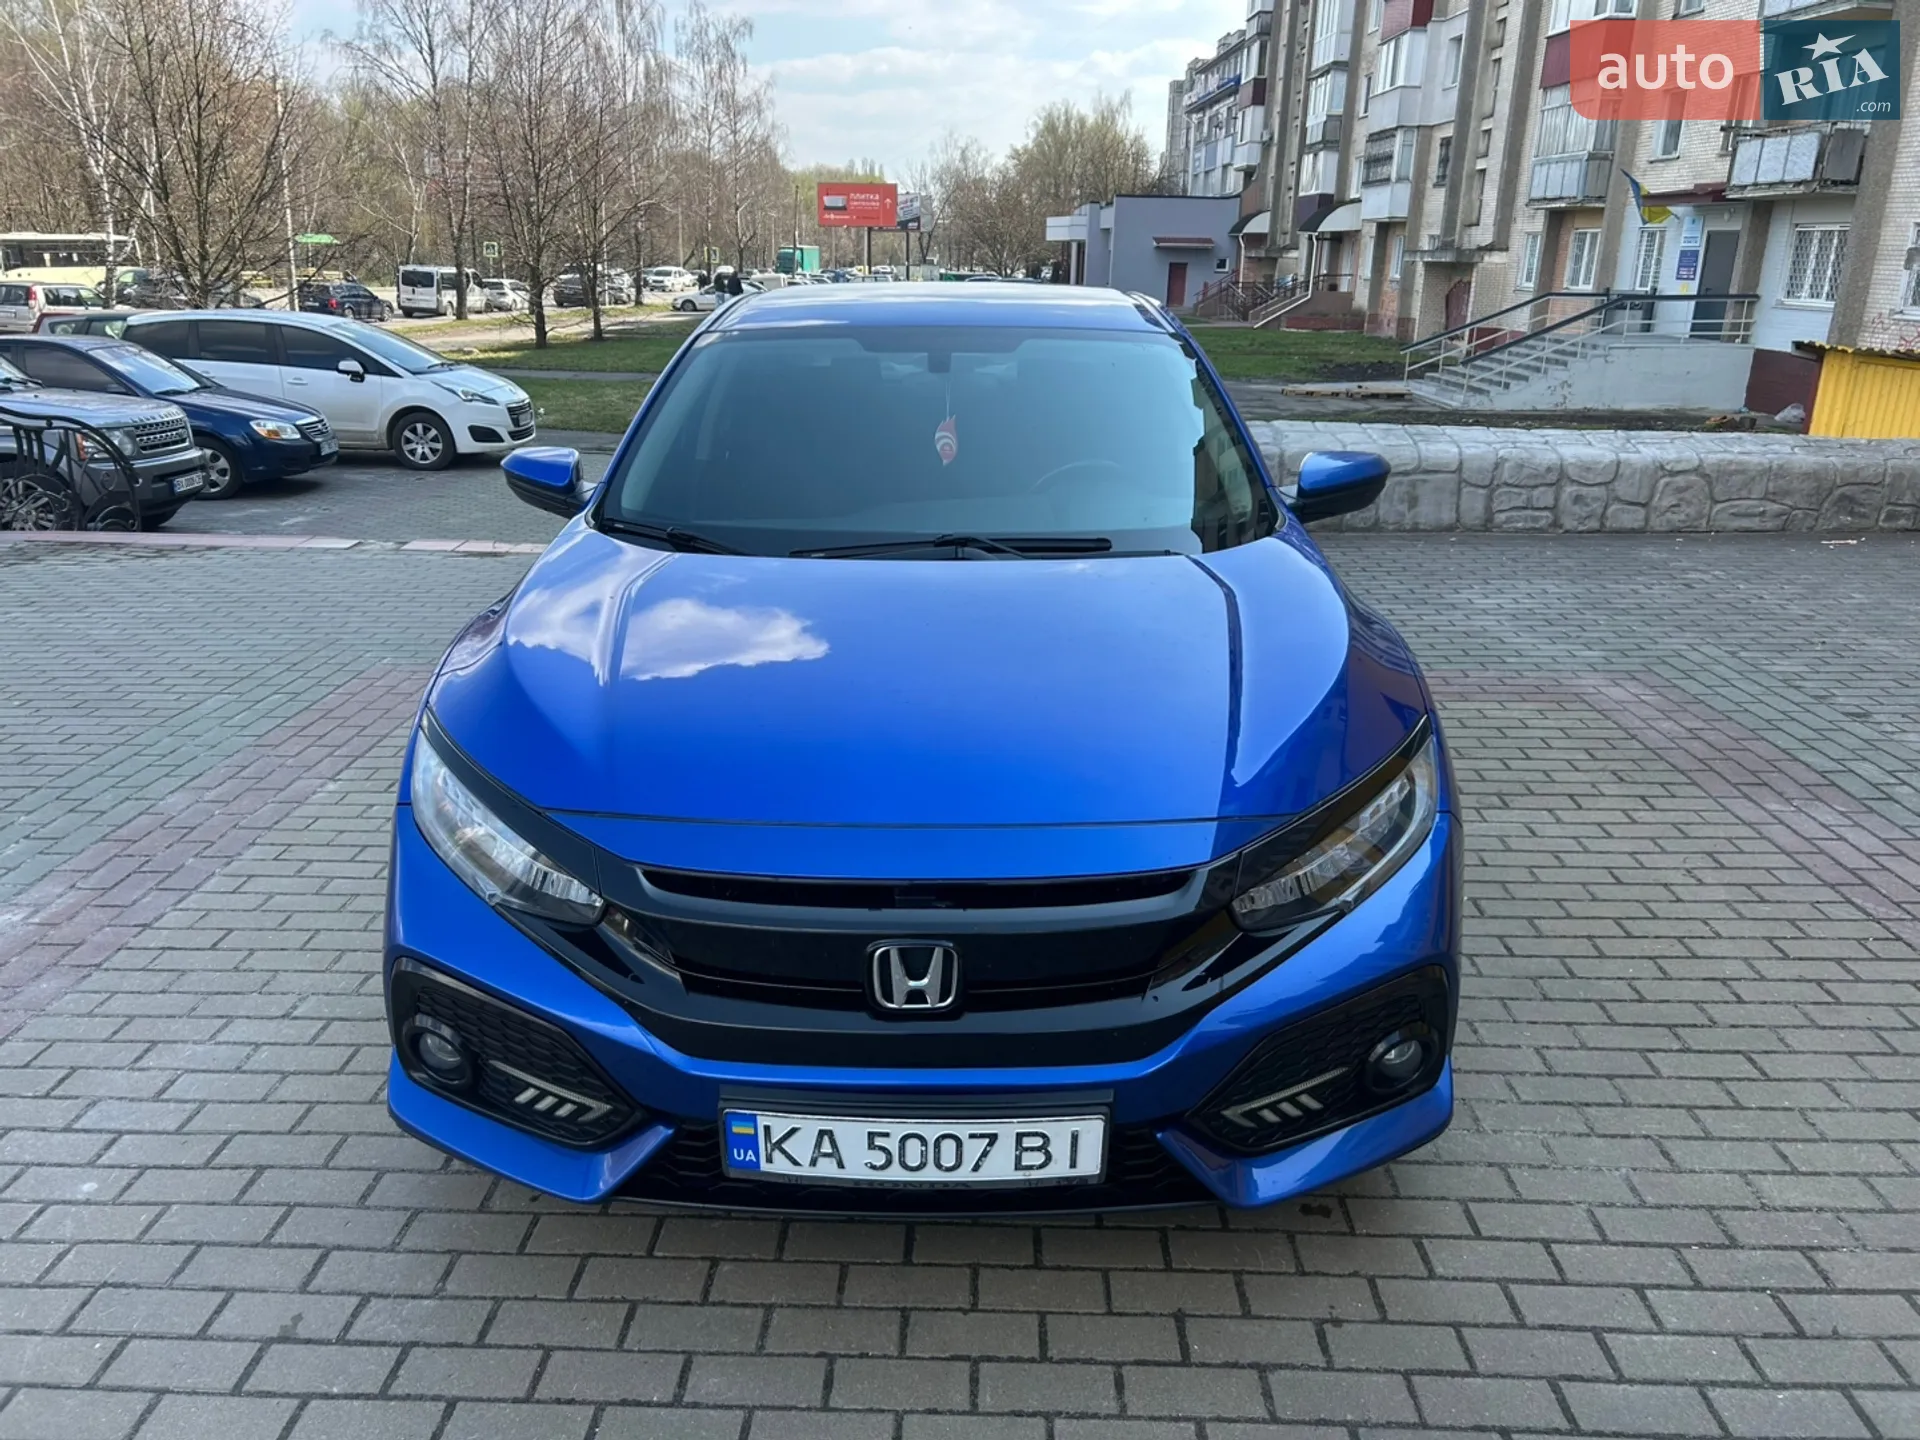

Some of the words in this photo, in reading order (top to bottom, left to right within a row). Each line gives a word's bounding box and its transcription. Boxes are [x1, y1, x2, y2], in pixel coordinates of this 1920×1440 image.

[733, 1148, 757, 1163] UA
[763, 1123, 846, 1170] KA
[864, 1130, 999, 1172] 5007
[1014, 1129, 1081, 1171] BI
